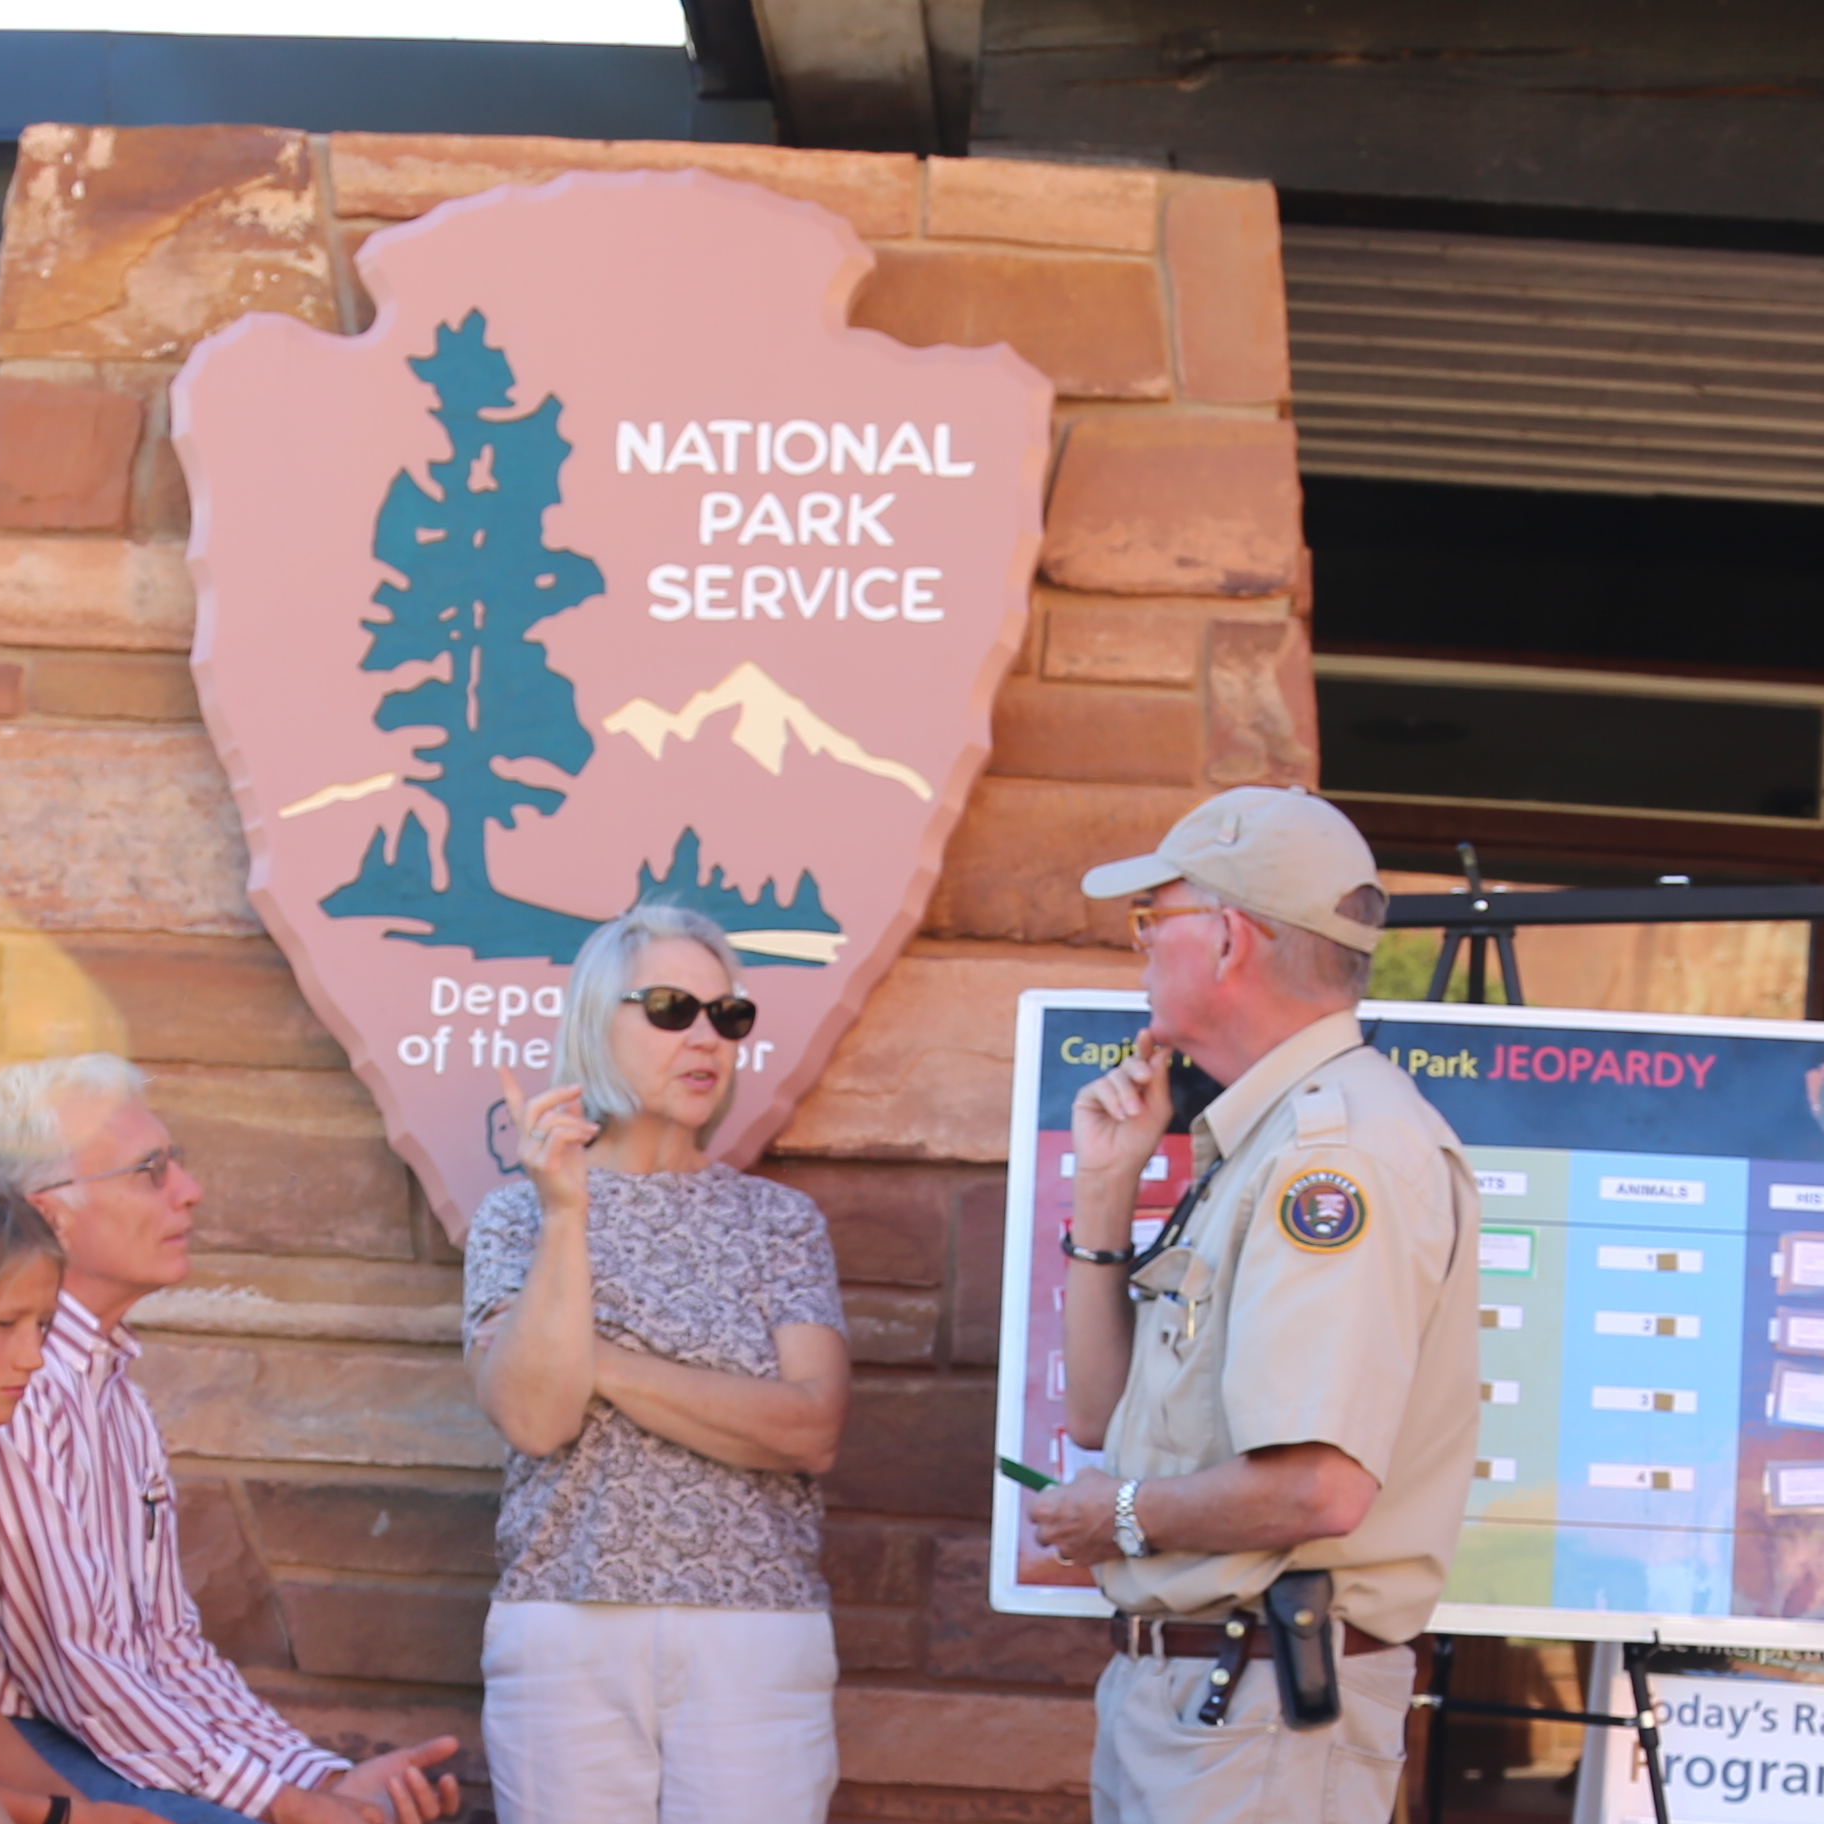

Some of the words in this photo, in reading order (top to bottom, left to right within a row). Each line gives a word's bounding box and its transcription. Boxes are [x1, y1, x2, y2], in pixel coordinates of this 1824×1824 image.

[615, 419, 975, 477] NATIONAL
[699, 491, 896, 546] PARK
[647, 563, 945, 622] SERVICE
[397, 1027, 452, 1074] of
[469, 1027, 550, 1069] the
[1408, 1048, 1478, 1080] Park
[1487, 1044, 1716, 1089] JEOPARDY
[1616, 1183, 1689, 1200] ANIMALS
[1657, 1695, 1778, 1739] oday's
